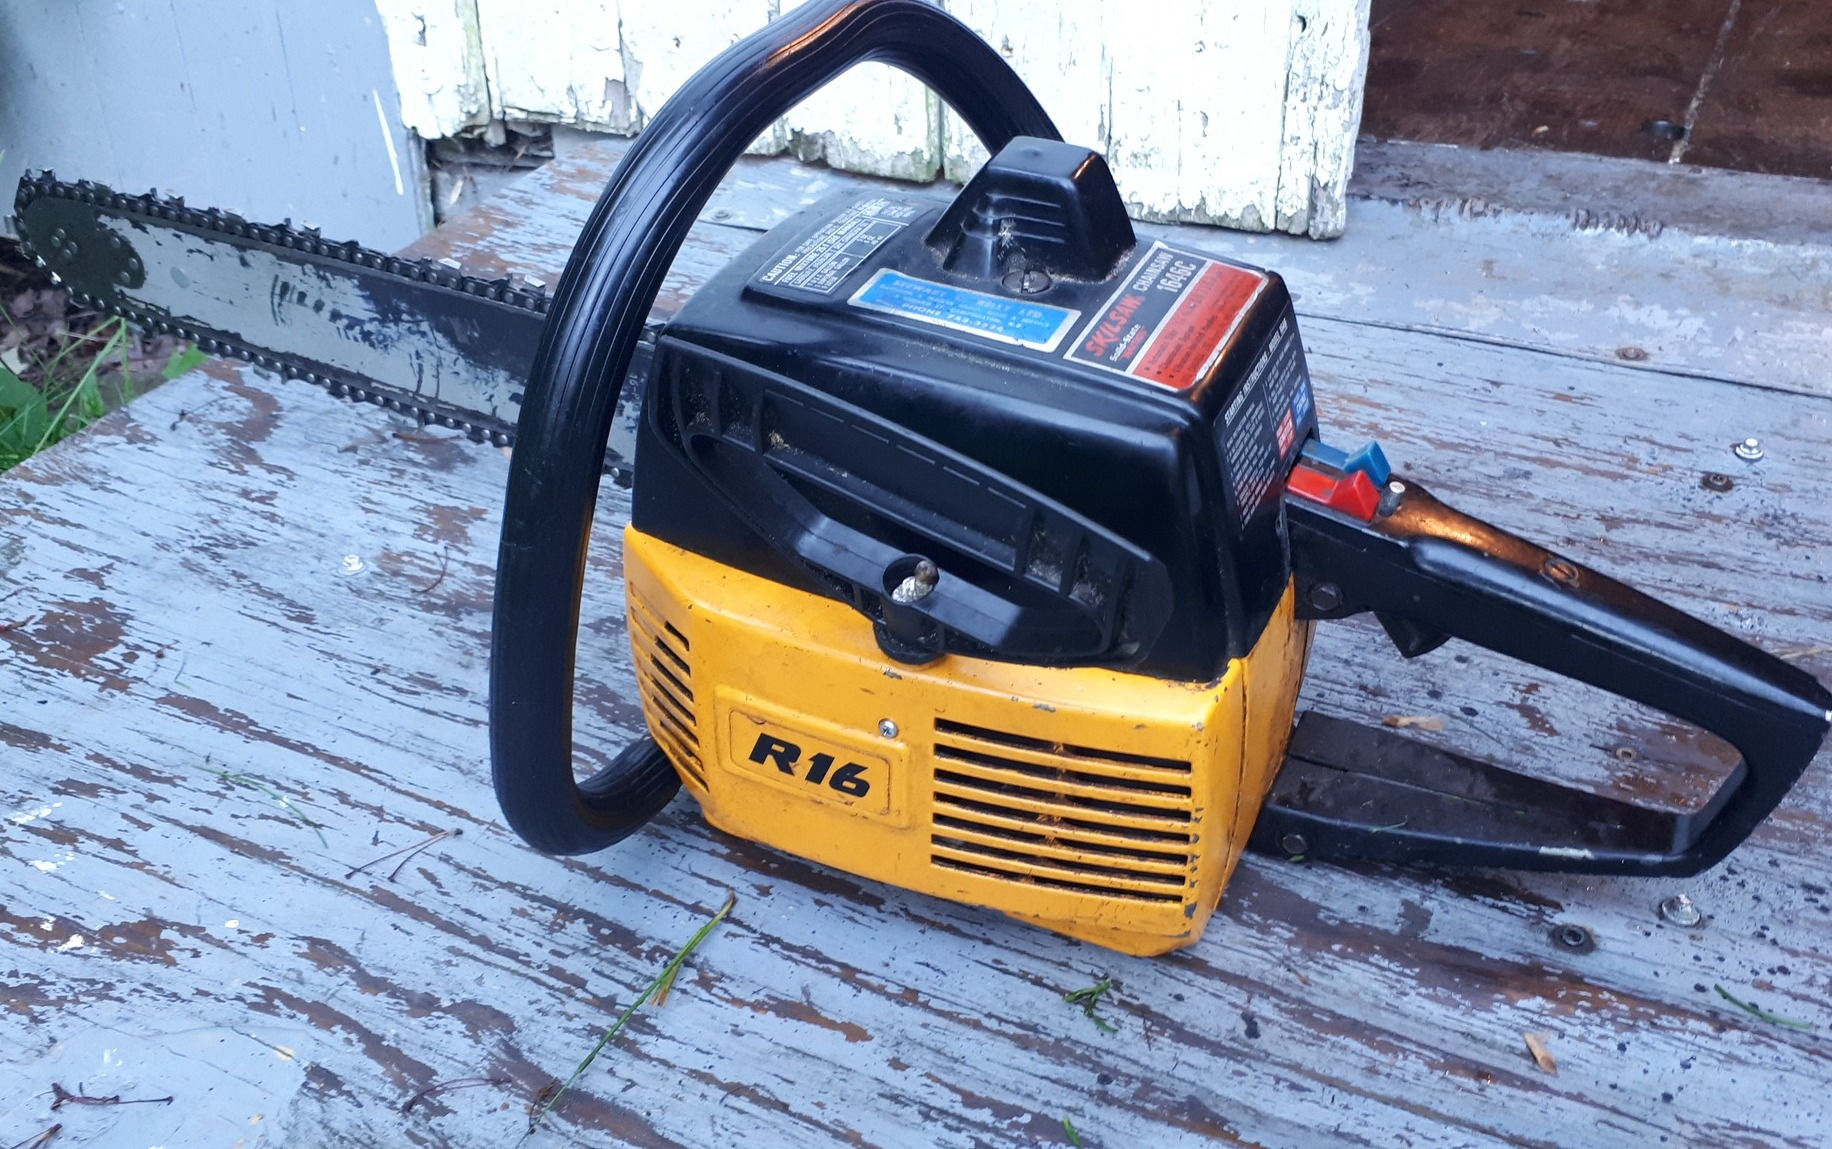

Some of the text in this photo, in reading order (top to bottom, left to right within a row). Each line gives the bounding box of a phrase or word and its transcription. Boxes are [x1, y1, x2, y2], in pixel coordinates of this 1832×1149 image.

[1132, 251, 1174, 292] CHAINSAW
[1156, 260, 1197, 293] 1646C
[901, 302, 944, 317] PHONE
[1085, 293, 1143, 358] SKILSAW
[1224, 390, 1244, 424] STARTING
[748, 732, 870, 798] R16
